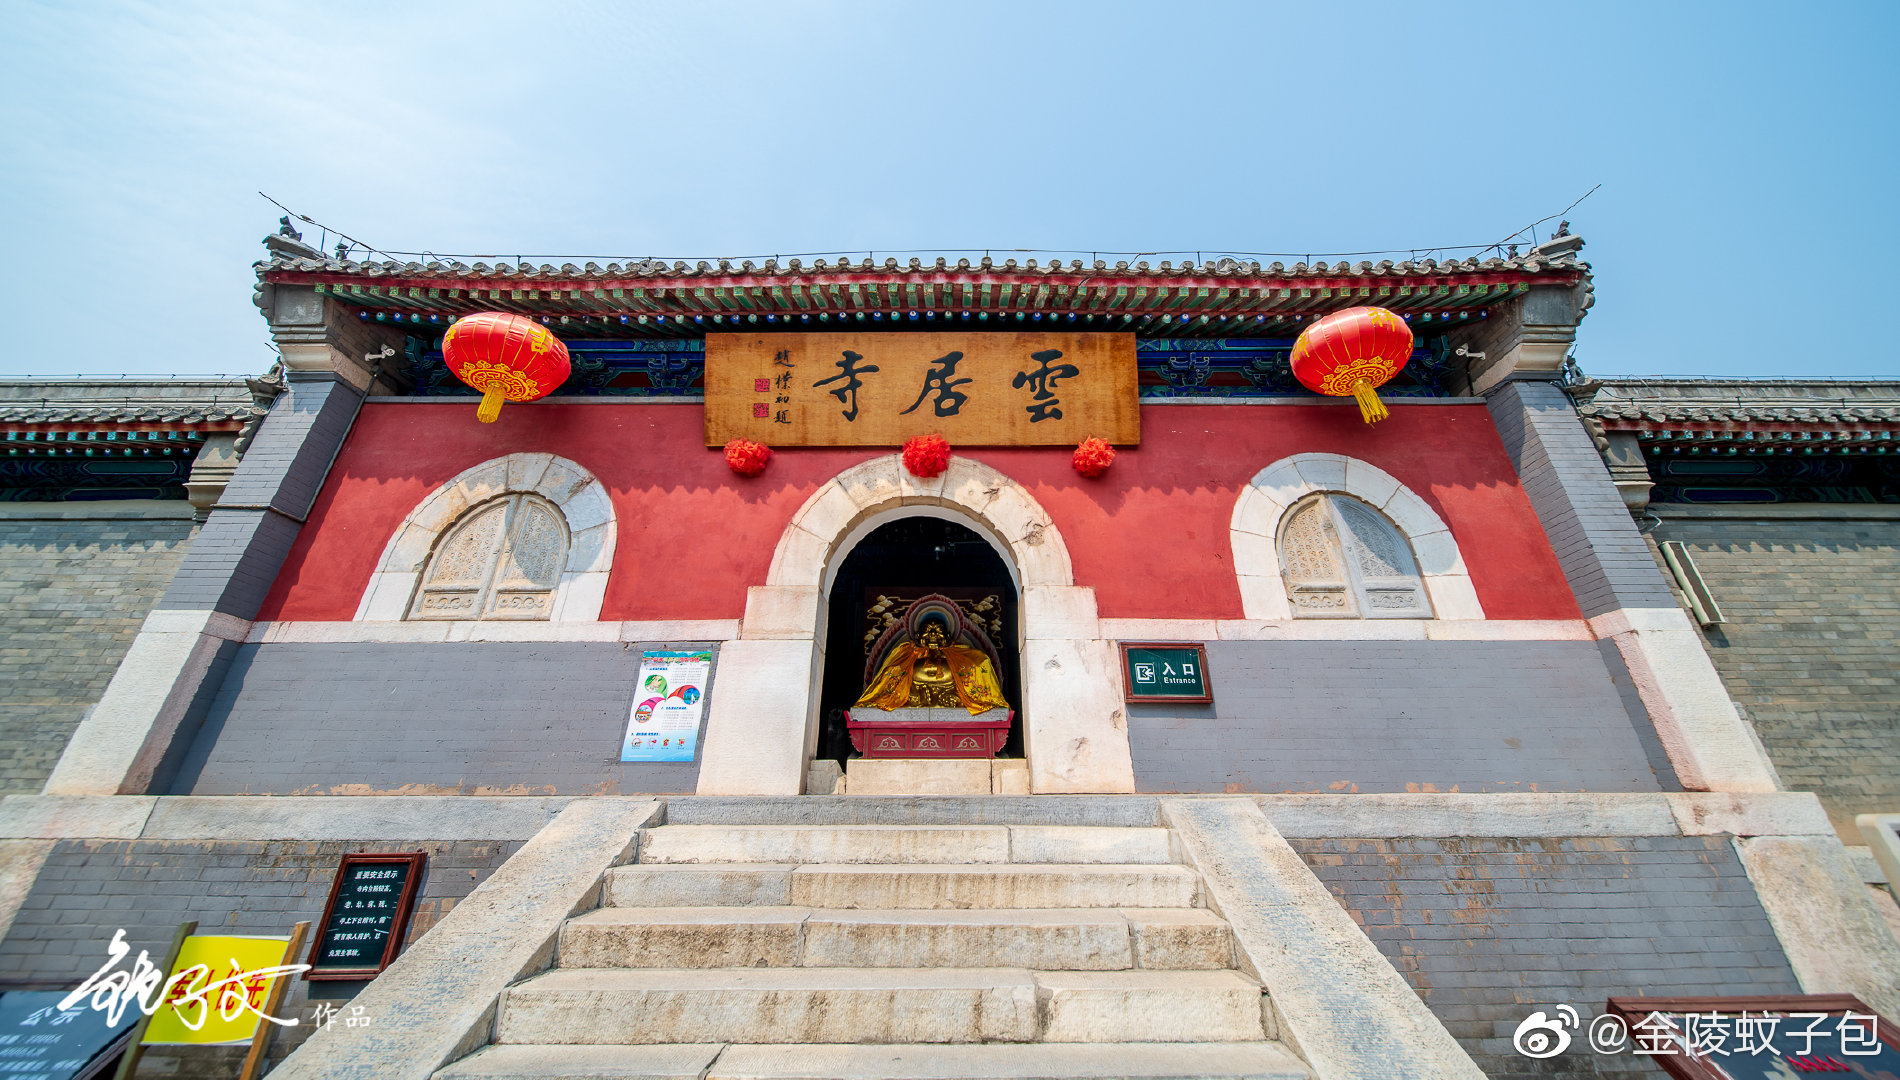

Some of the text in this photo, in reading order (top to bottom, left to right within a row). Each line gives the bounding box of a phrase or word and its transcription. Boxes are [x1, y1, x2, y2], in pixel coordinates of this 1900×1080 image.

[812, 349, 1080, 423] 雲居寺
[1162, 661, 1195, 676] 入口
[1163, 676, 1196, 684] Entrance
[354, 870, 398, 880] 重要安全提示
[19, 1006, 88, 1026] 公示
